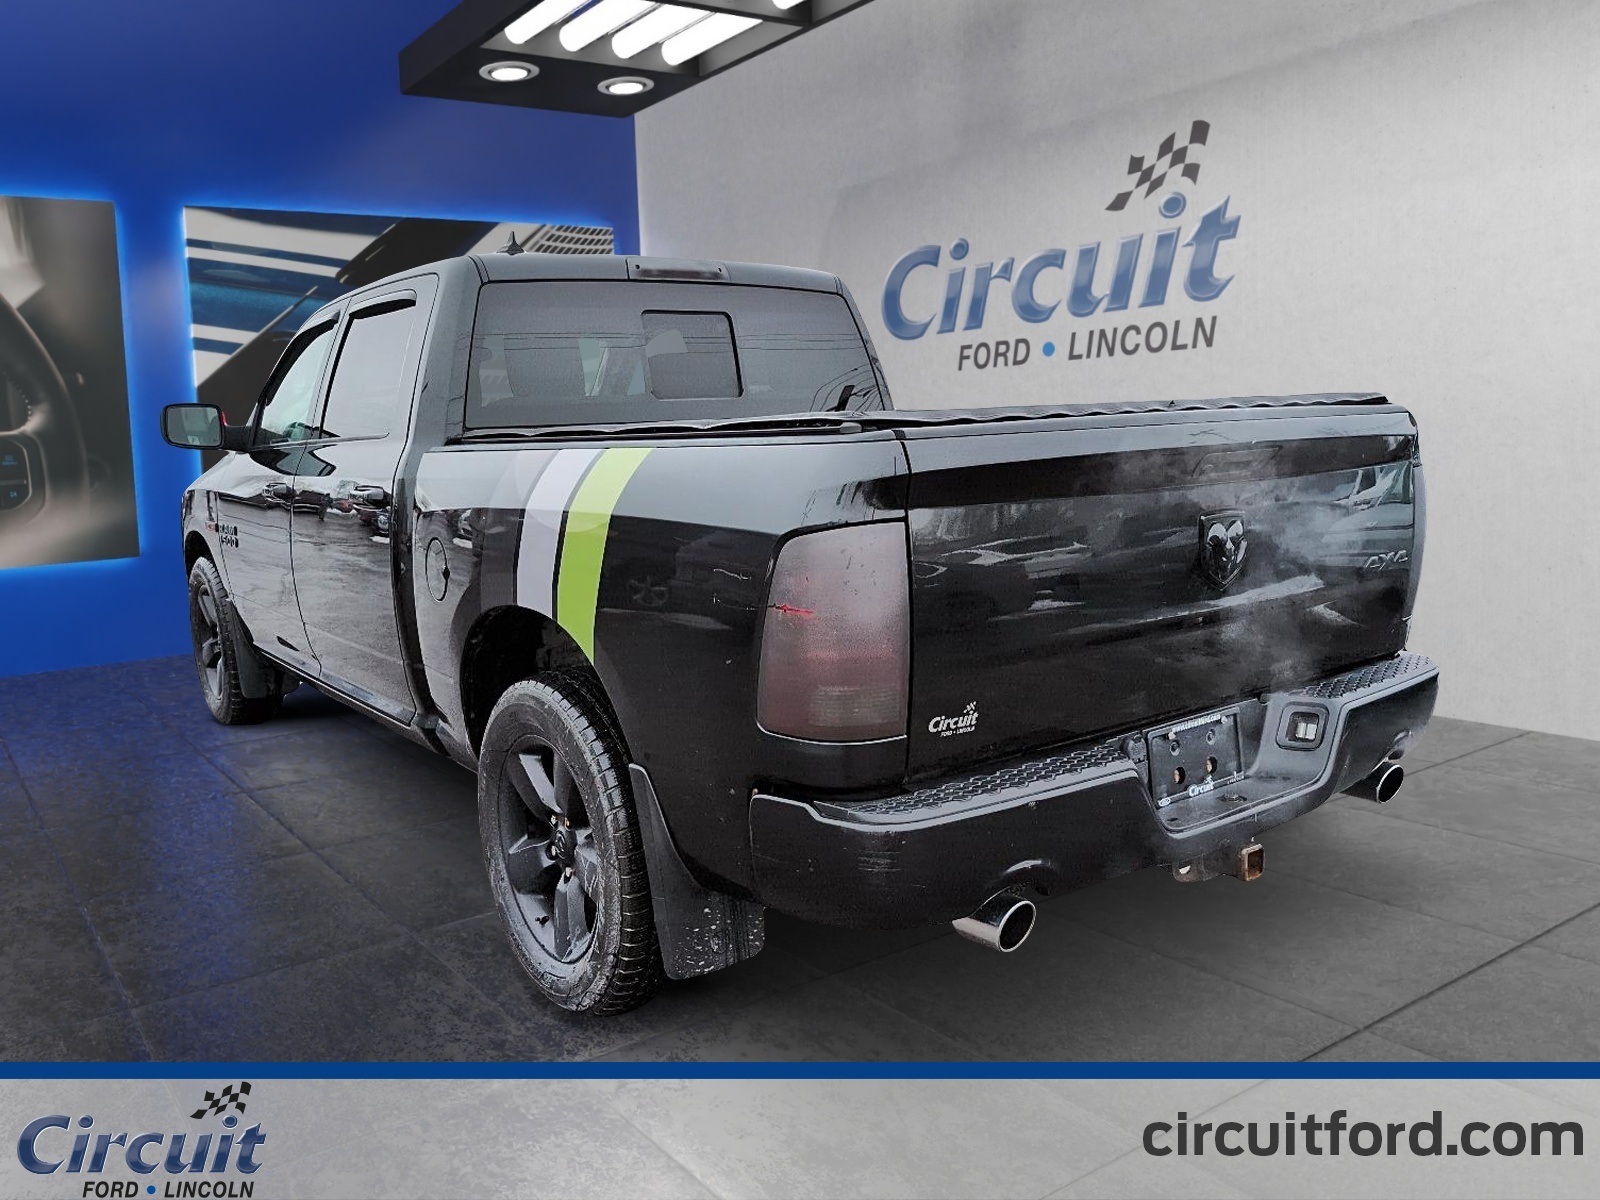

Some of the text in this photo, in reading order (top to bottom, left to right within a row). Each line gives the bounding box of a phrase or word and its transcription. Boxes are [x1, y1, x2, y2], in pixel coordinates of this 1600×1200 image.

[881, 191, 1241, 341] Circuit
[958, 315, 1217, 371] FORD LINCOLN
[928, 711, 979, 733] Circuit
[1187, 780, 1215, 797] Circuit
